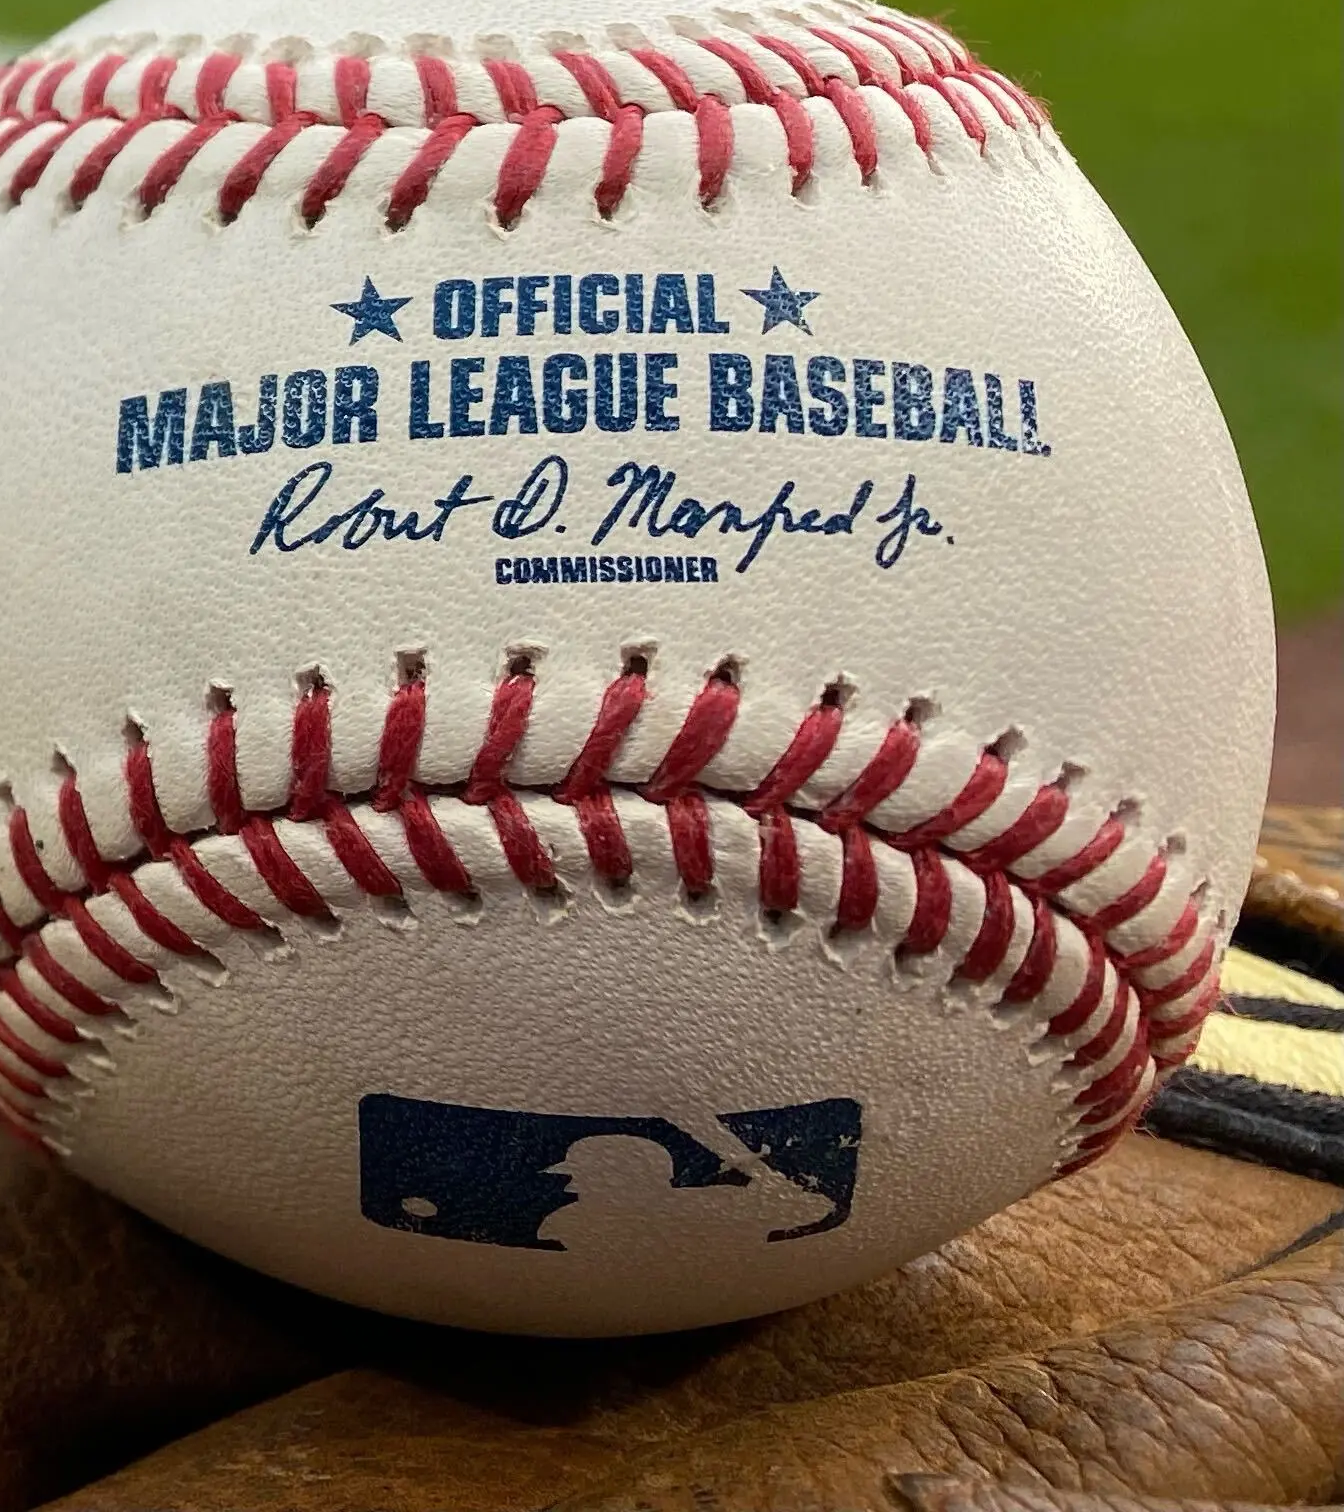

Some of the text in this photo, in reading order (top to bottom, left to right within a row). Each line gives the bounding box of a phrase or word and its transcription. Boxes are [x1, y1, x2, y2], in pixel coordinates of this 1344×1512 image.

[433, 272, 730, 339] OFFICIAL
[115, 352, 1052, 475] MAJOR LEAGUE BASEBALL
[495, 555, 719, 584] COMMISSIONER
